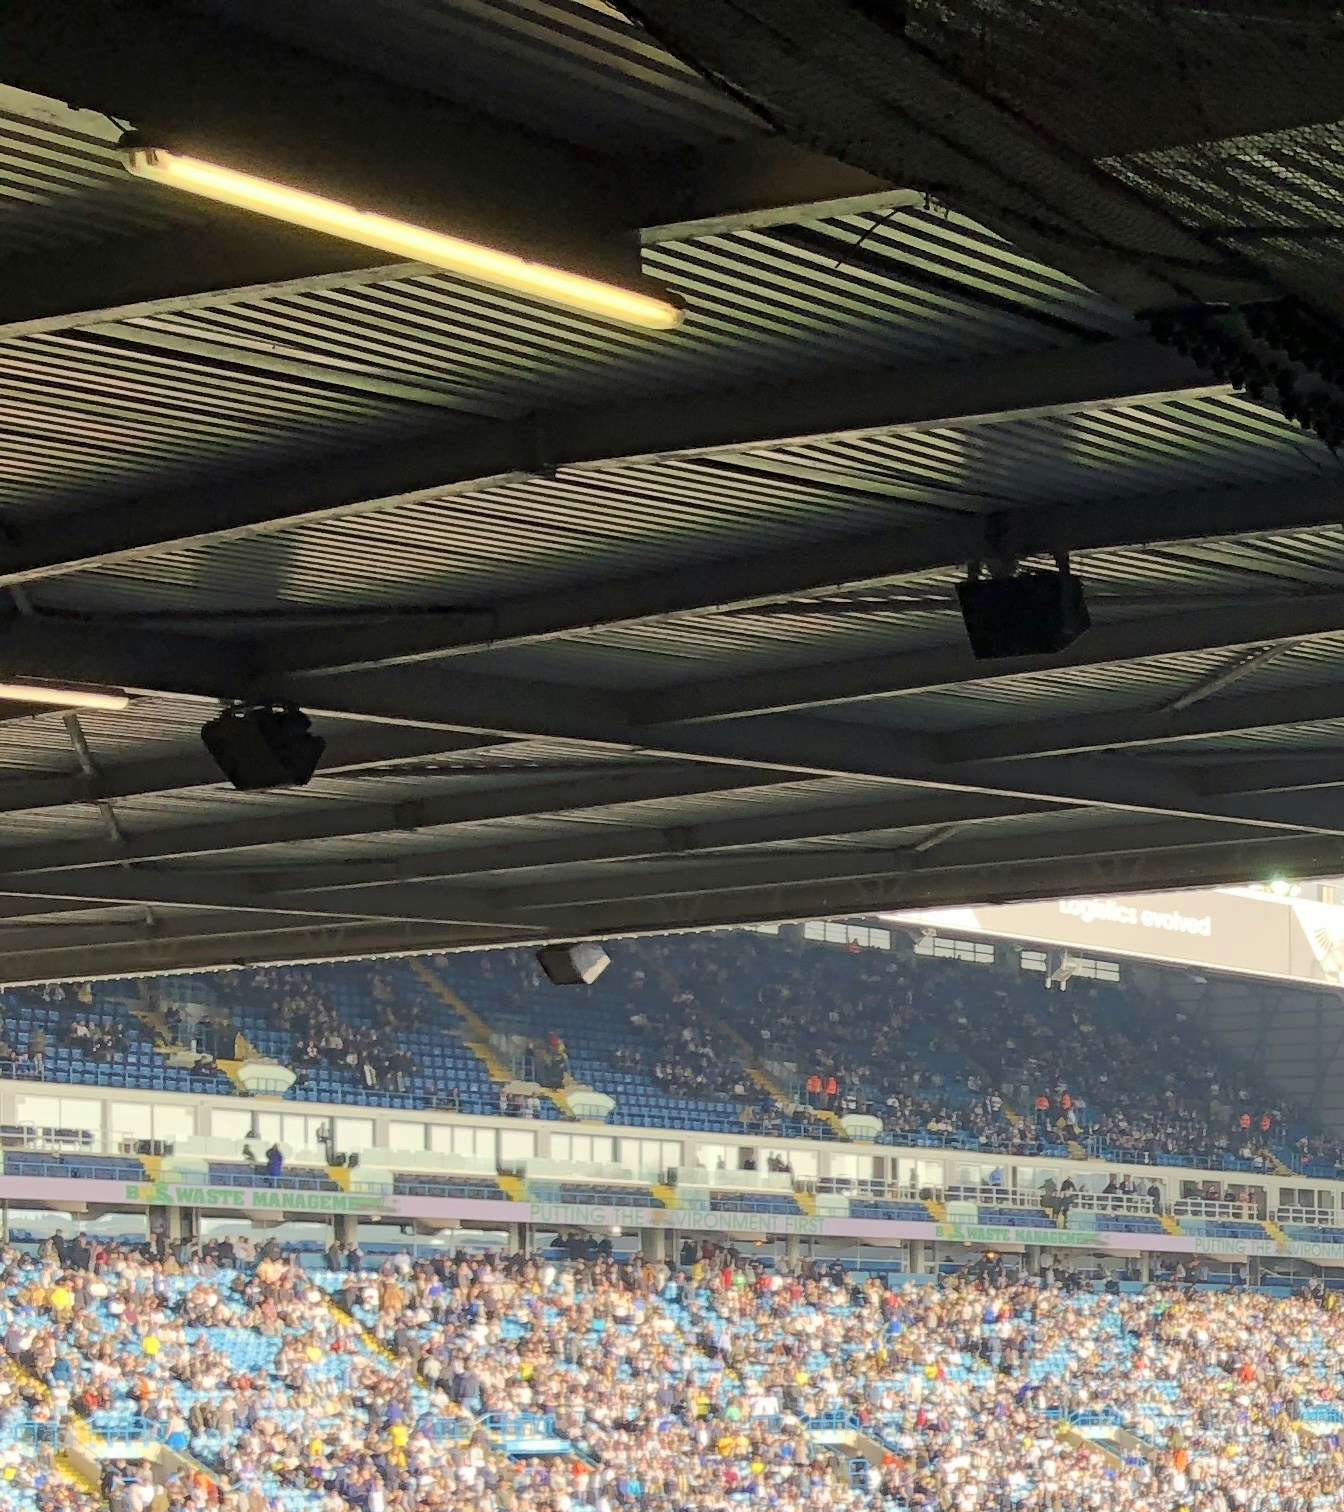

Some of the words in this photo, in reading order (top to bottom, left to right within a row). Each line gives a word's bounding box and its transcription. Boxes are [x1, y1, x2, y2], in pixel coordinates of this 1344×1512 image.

[1140, 909, 1212, 938] evolved
[176, 1186, 245, 1206] WASTE
[530, 1205, 605, 1225] PUTTING
[614, 1208, 644, 1226] THE
[785, 1215, 826, 1234] FIRST
[968, 1225, 1010, 1242] WASTE
